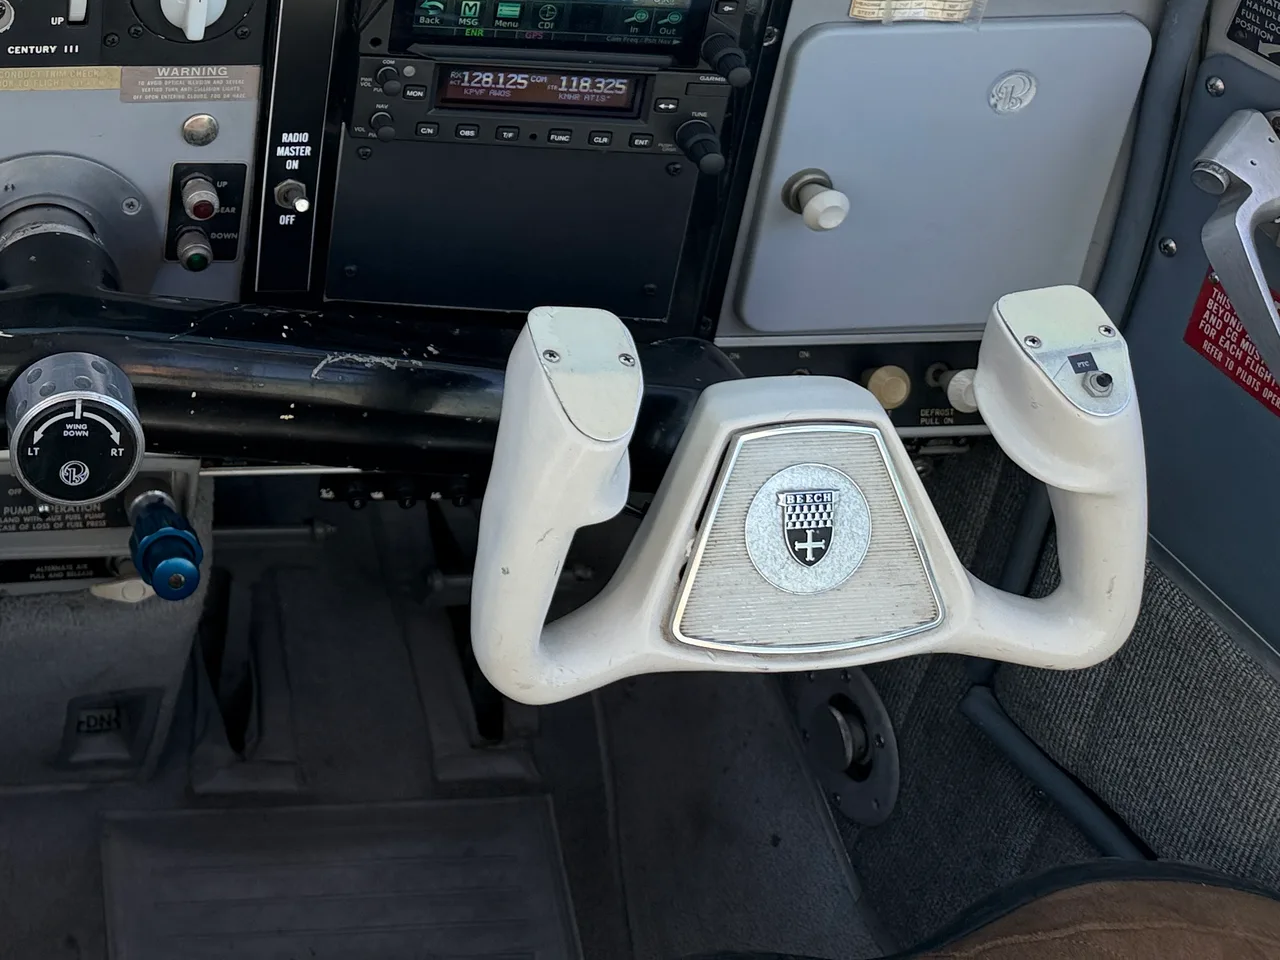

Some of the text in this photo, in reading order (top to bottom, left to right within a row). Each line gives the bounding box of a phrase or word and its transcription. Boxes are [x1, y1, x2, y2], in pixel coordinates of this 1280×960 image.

[51, 17, 64, 25] UP
[1241, 9, 1260, 24] FULL
[1236, 17, 1273, 42] POSITION
[8, 46, 56, 54] CENTURY
[158, 68, 228, 76] WARNING
[461, 71, 528, 89] 128.125
[559, 76, 627, 93] 118.325
[282, 133, 309, 142] RADIO
[277, 146, 311, 156] MASTER
[286, 160, 299, 169] ON
[279, 215, 295, 225] OFF
[211, 232, 238, 240] DOWN
[1206, 298, 1243, 332] BEYOND
[1199, 320, 1242, 360] FOR EACH
[1202, 340, 1261, 392] REFER PILOTS
[28, 447, 39, 456] LT
[111, 448, 124, 457] RT
[786, 492, 832, 503] BEECH
[4, 506, 33, 515] PUMP
